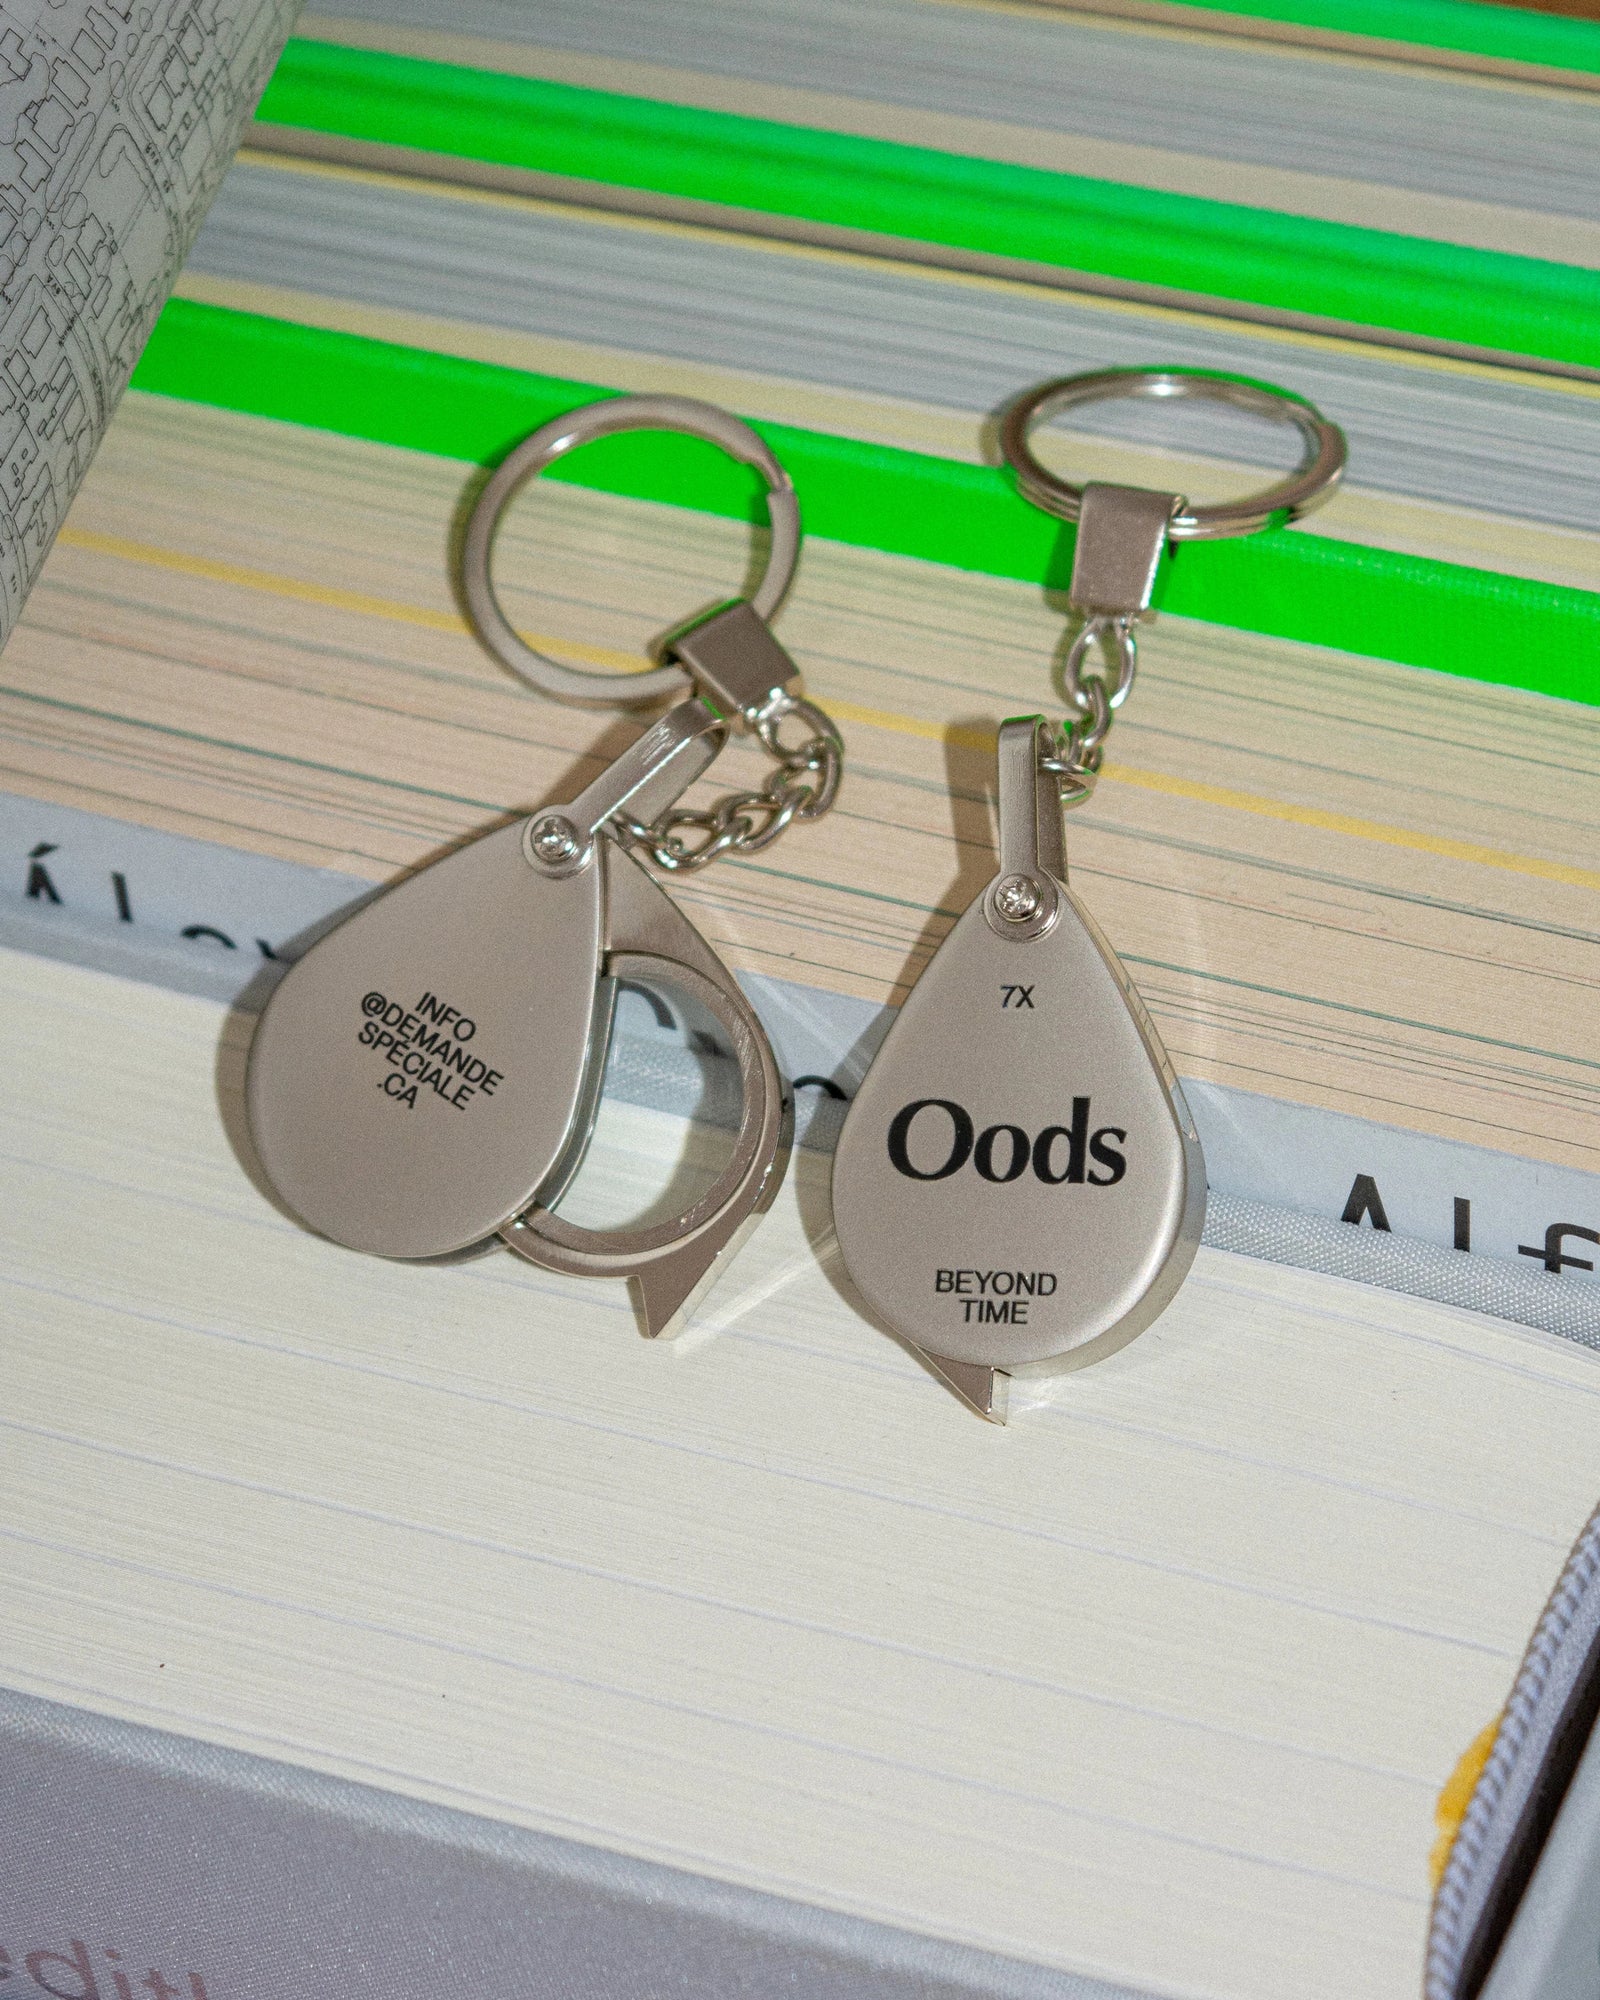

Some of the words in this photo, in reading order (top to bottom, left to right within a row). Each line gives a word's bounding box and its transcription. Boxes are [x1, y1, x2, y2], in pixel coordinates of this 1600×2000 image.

[1000, 985, 1035, 1009] 7X
[415, 991, 477, 1042] INFO
[361, 991, 505, 1096] @DEMANDE
[376, 1073, 419, 1109] .CA
[887, 1096, 1129, 1186] Oods
[935, 1269, 1058, 1297] BEYOND
[959, 1300, 1030, 1325] TIME
